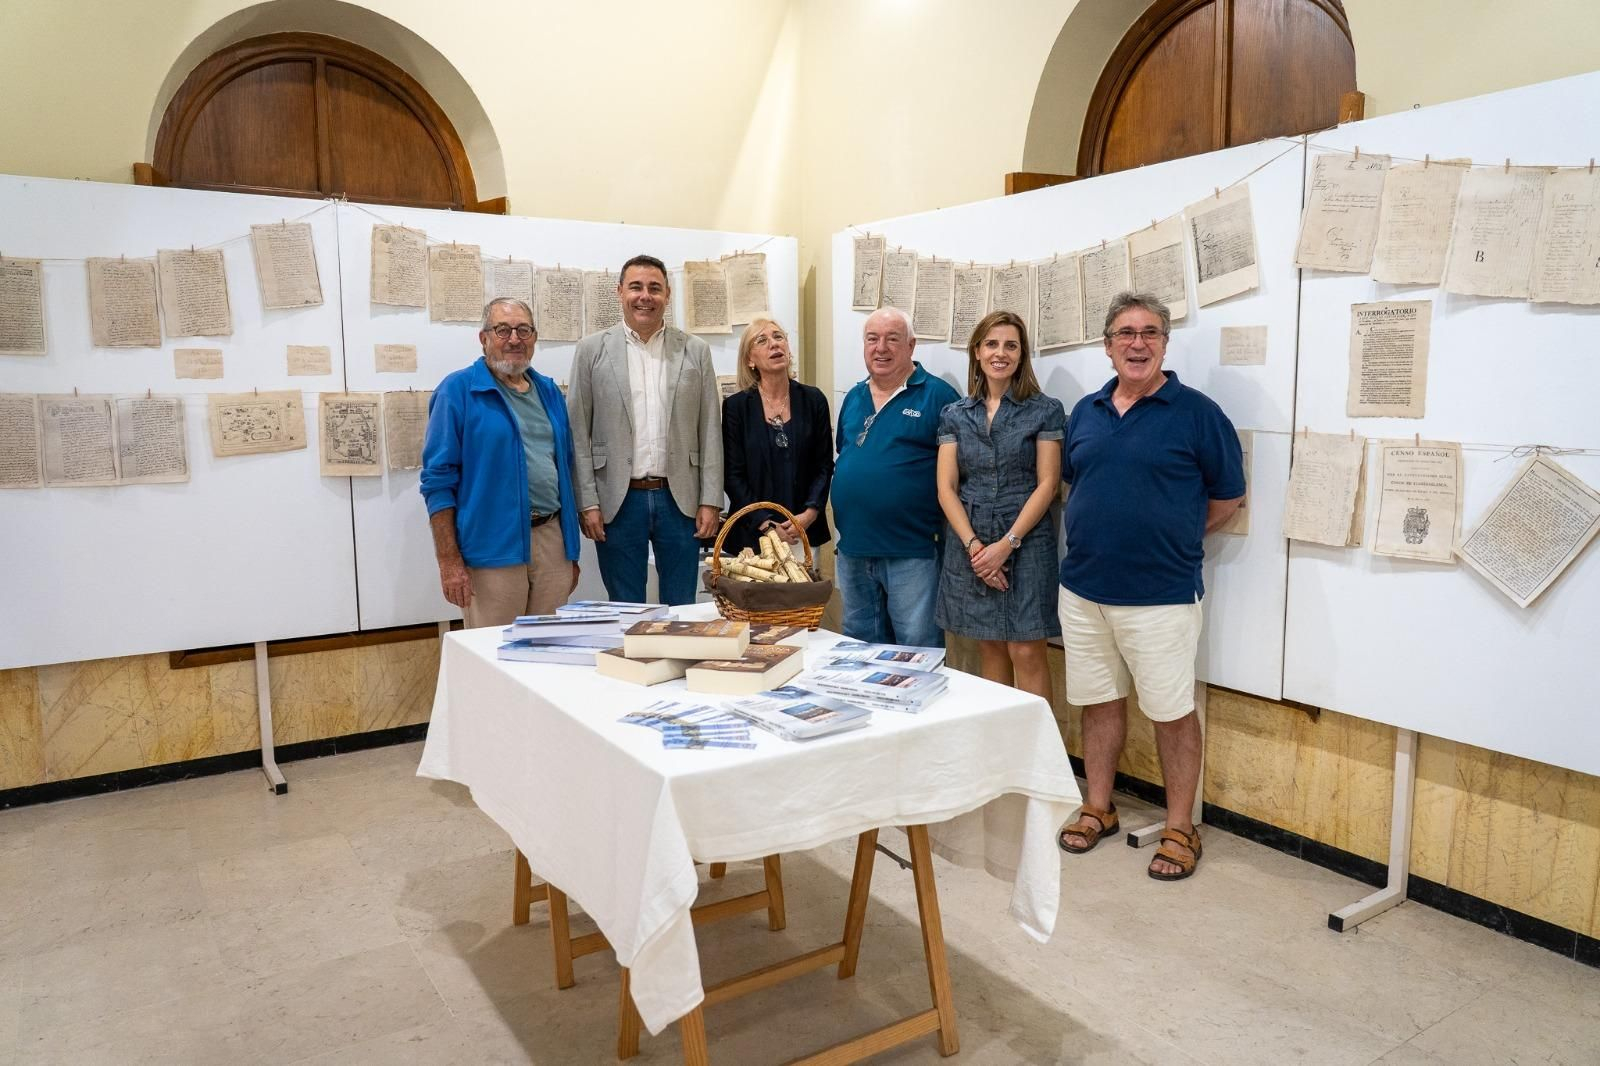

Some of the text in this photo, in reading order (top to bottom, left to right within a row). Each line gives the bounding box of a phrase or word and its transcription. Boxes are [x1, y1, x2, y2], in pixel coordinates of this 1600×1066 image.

[1475, 250, 1484, 262] B
[1357, 308, 1417, 317] INTERROGATORIO
[1418, 450, 1450, 458] ESPAÑOL
